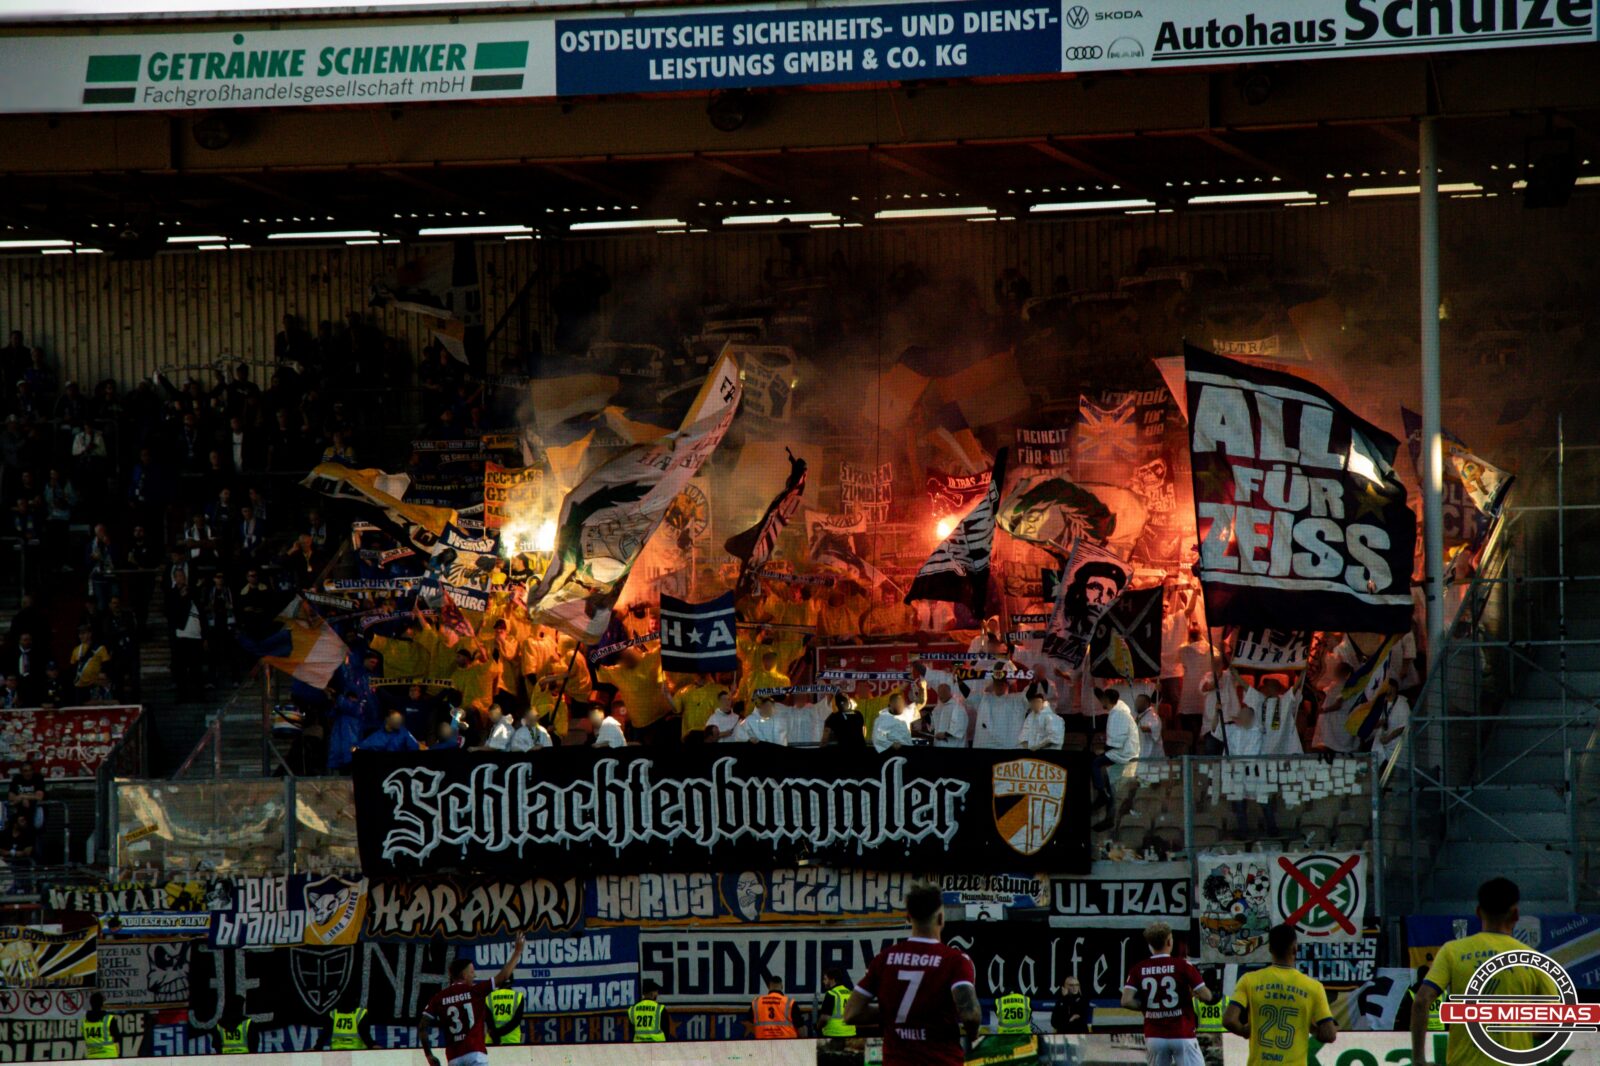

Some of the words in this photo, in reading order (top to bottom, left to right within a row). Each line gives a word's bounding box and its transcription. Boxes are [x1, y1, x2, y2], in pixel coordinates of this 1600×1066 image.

[560, 25, 724, 53] OSTDEUTSCHE
[732, 17, 893, 47] SICHERHEITS-
[901, 13, 955, 37] UND
[963, 8, 1058, 34] DIENST-
[1153, 13, 1337, 52] Autohaus
[1344, 0, 1593, 42] Schulze
[316, 43, 467, 77] SCHENKER
[649, 53, 775, 81] LEISTUNGS
[783, 49, 853, 74] GMBH
[861, 48, 879, 70] &
[886, 45, 926, 69] CO.
[936, 43, 967, 66] KG
[143, 77, 415, 107] Fachgroßhandelsgesellschaft
[420, 75, 466, 94] mbH
[1232, 463, 1346, 519] FÜR
[1198, 501, 1394, 594] ZEISS
[996, 762, 1025, 779] CARL
[1028, 763, 1063, 780] ZEISS
[1007, 780, 1051, 794] JENA
[380, 755, 972, 864] Schlachtenbummler
[47, 887, 172, 912] WEIMAR
[369, 876, 578, 934] HARAKIRI
[1054, 881, 1188, 915] ULTRAS
[121, 916, 177, 928] ADOLESCENT
[179, 916, 208, 927] CREW
[215, 909, 305, 946] branco
[531, 969, 551, 978] UND
[641, 937, 906, 995] SÜDKURV
[886, 952, 943, 968] ENERGIE
[1141, 963, 1175, 976] ENERGIE
[442, 990, 473, 1006] ENERGIE
[894, 969, 926, 1025] 7
[1141, 975, 1180, 1010] 23
[335, 1017, 353, 1031] 475
[446, 1002, 476, 1035] 31
[493, 1003, 512, 1016] 294
[636, 1014, 653, 1028] 287
[768, 1006, 776, 1020] 3
[1003, 1007, 1024, 1020] 256
[1201, 1005, 1220, 1018] 288
[85, 1026, 102, 1038] 144
[686, 1013, 738, 1041] MIT
[894, 1027, 927, 1042] THIELE
[1258, 1003, 1300, 1050] 25
